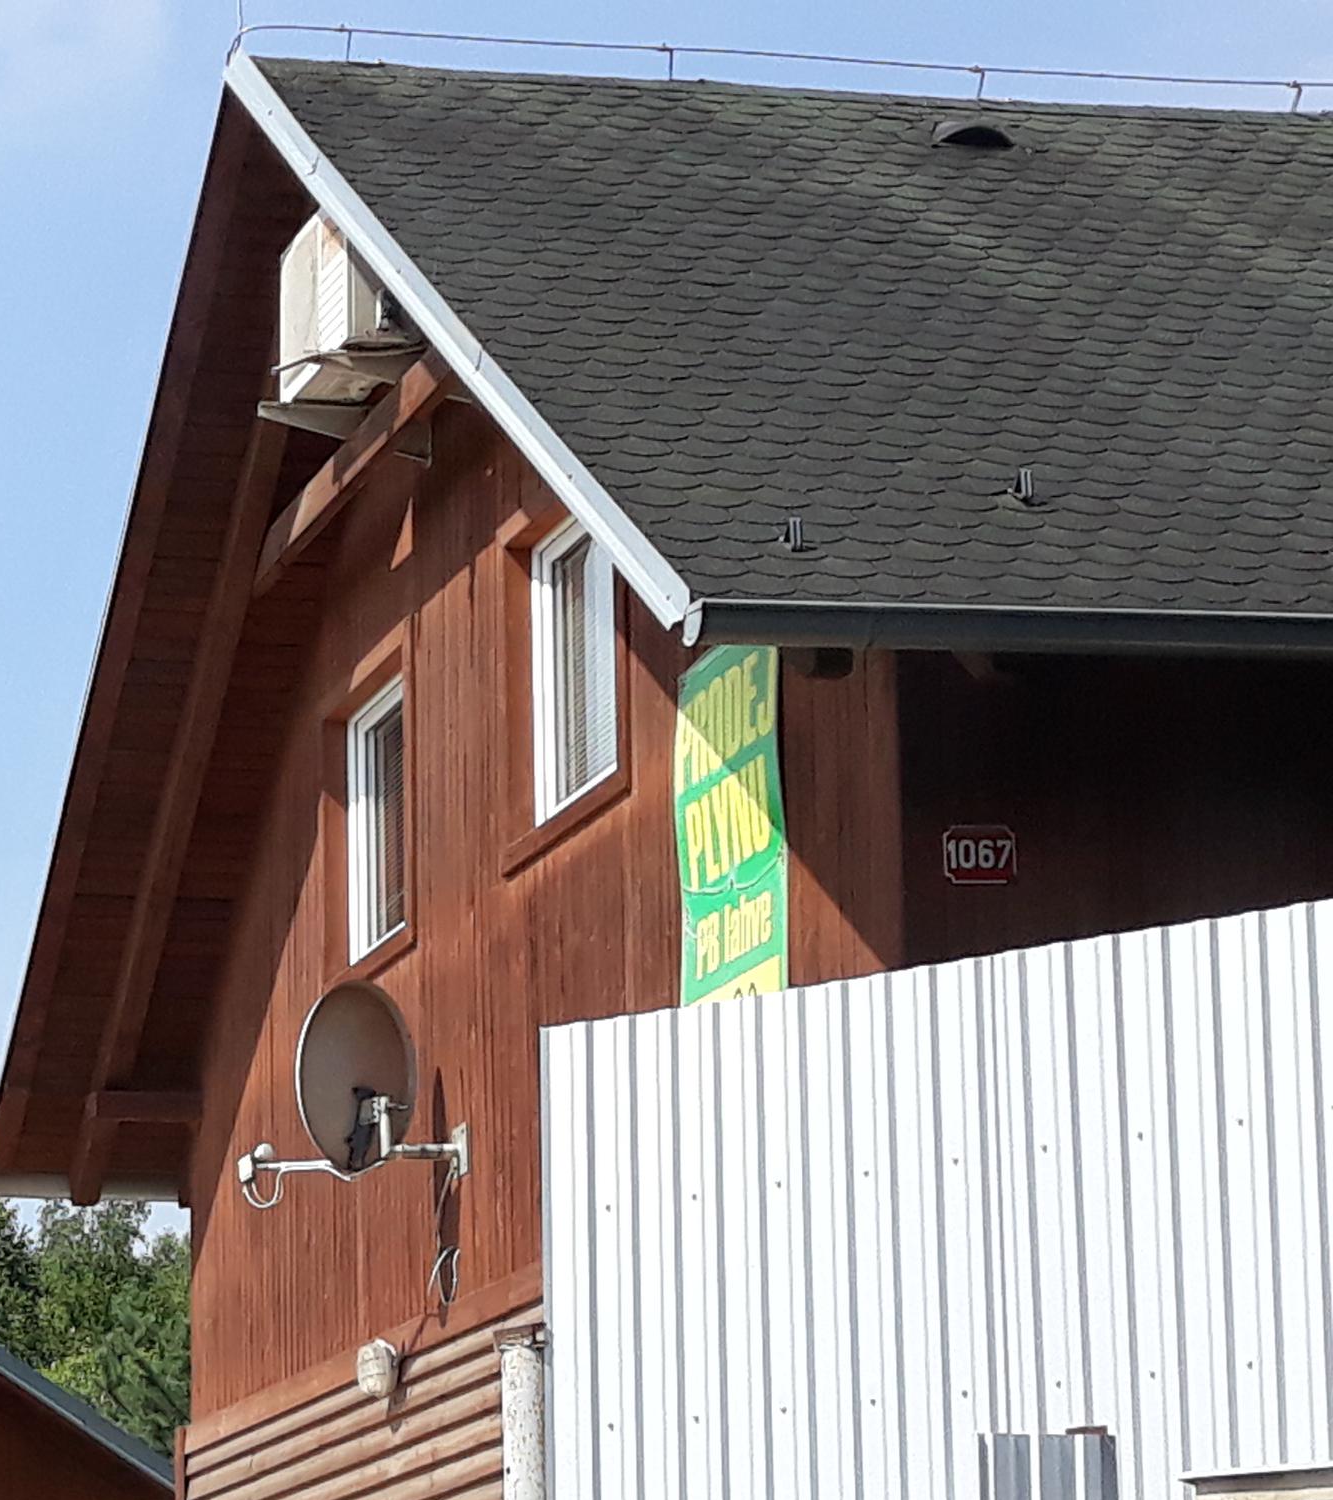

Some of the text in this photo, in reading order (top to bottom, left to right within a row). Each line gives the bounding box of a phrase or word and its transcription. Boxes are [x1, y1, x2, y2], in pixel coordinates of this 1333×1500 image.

[675, 648, 779, 796] PRODEJ
[686, 753, 771, 891] PLYNU
[947, 839, 1011, 870] 1067
